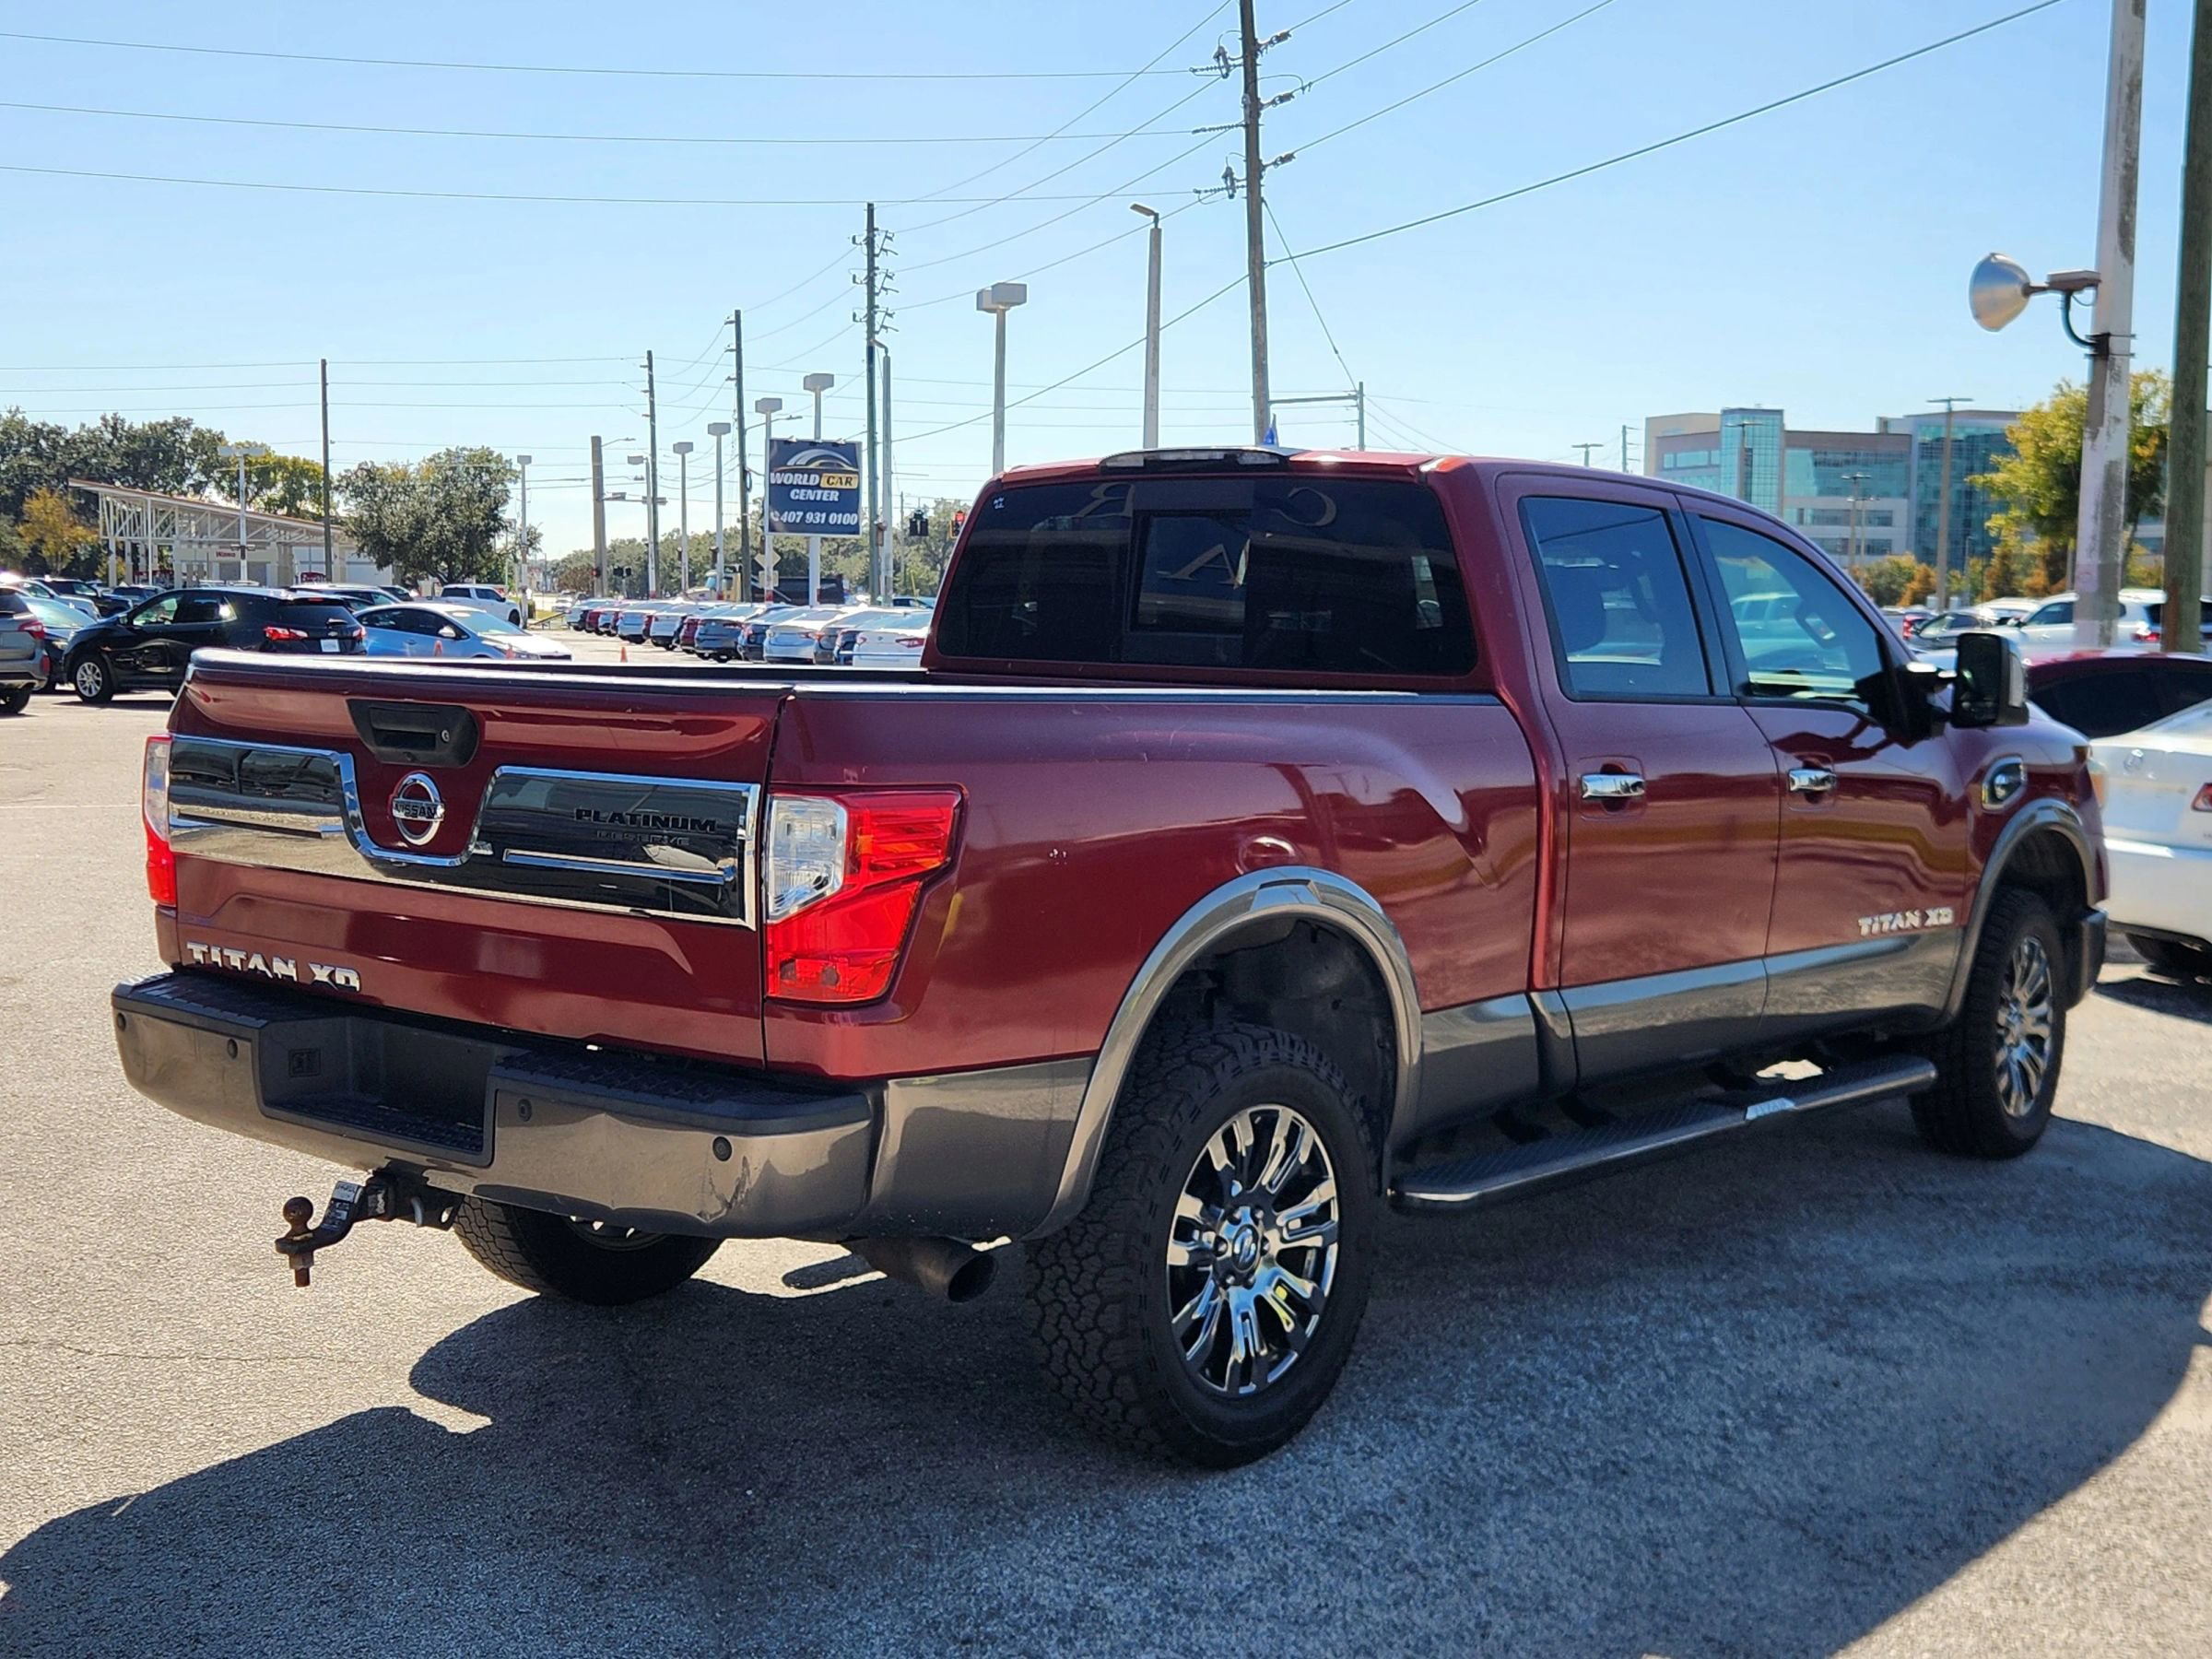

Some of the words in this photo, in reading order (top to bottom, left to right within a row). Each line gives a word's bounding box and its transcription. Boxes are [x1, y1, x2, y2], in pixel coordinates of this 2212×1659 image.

[770, 472, 820, 486] WORLD
[826, 476, 853, 486] CAR
[789, 488, 840, 501] CENTER
[780, 511, 804, 524] 407
[805, 512, 827, 524] 931
[829, 512, 858, 525] 0100
[394, 802, 437, 819] NISSAN
[574, 807, 718, 833] PLATINUM
[1857, 909, 1922, 937] TITAN
[1924, 906, 1954, 927] XD
[186, 940, 299, 982] TITAN
[308, 961, 361, 993] XD
